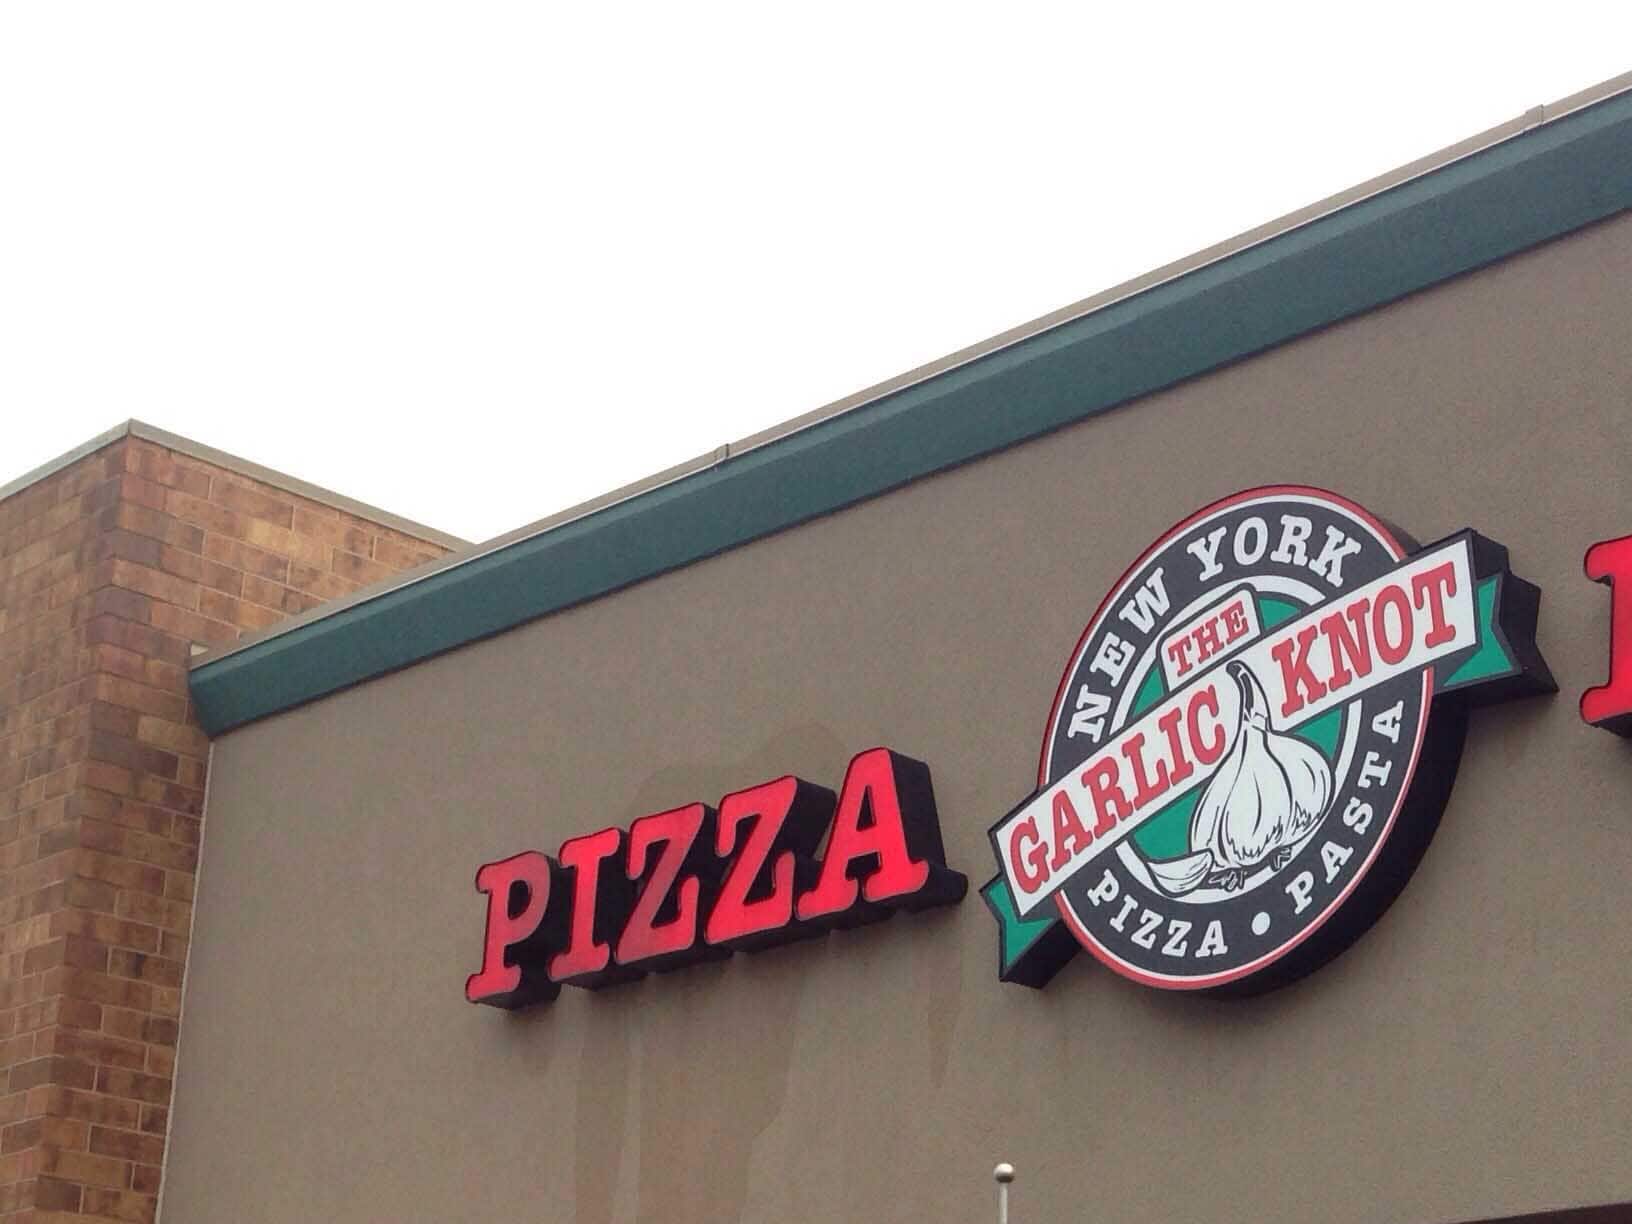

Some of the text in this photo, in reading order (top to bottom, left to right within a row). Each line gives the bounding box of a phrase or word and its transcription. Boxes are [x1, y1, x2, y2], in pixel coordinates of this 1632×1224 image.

[1009, 561, 1458, 896] GARLIC KNOT
[1067, 513, 1362, 743] NEW YORK
[1167, 598, 1249, 679] THE
[465, 746, 932, 1003] PIZZA
[1087, 700, 1403, 958] PIZZA PASTA
